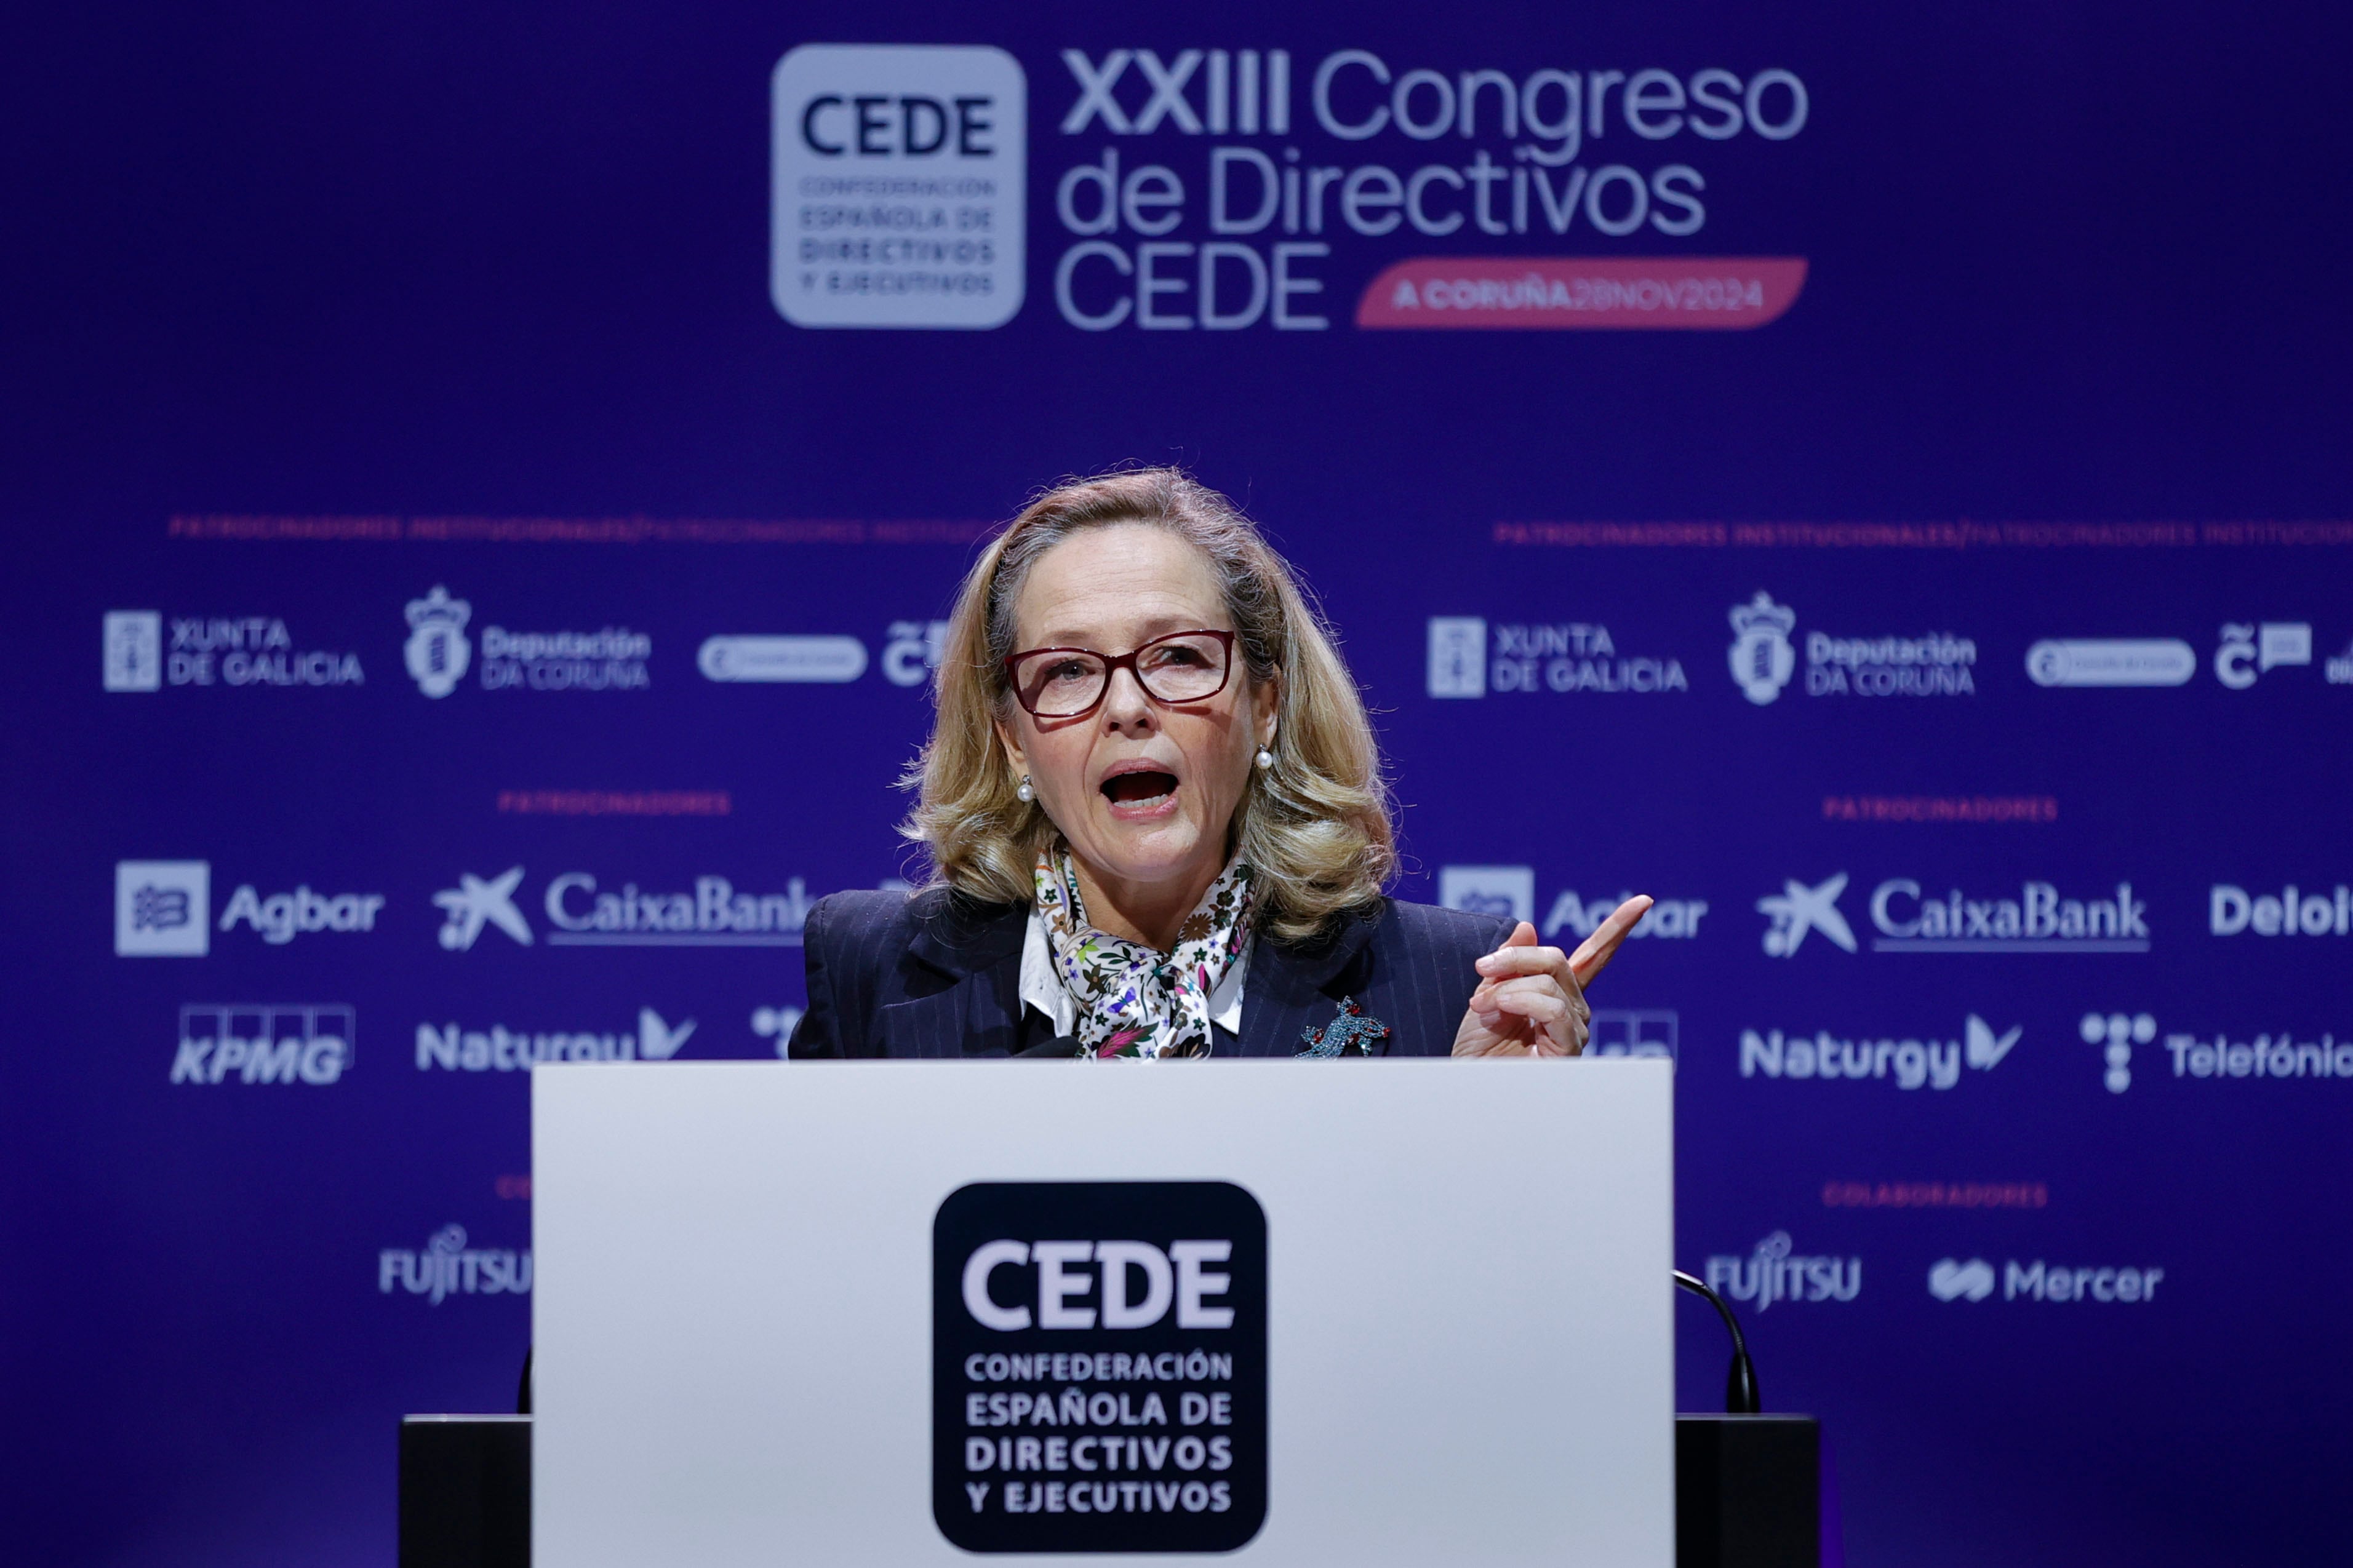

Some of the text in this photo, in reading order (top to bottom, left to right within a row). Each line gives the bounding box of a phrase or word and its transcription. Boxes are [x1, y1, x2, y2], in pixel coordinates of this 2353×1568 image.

[1062, 49, 1808, 167] XXIII Congreso
[801, 95, 994, 157] CEDE
[1057, 146, 1705, 236] de Directivos
[800, 205, 993, 230] ESPAÑOLA DE
[799, 238, 995, 264] DIRECTIVOS
[800, 271, 994, 295] Y EJECUTIVOS
[1055, 241, 1330, 330] CEDE
[1392, 279, 1421, 309] A
[1493, 521, 1727, 546] PATROCINADORES
[172, 618, 292, 652] XUNTA
[482, 626, 651, 664] Deputación
[1495, 624, 1615, 658] XUNTA
[1806, 632, 1977, 669] Deputación
[168, 652, 365, 686] DE GALICIA
[481, 658, 650, 690] DA CORUÑA
[1492, 658, 1688, 693] DE GALICIA
[1805, 666, 1975, 696] DA CORUÑA
[1823, 797, 2058, 822] PATROCINADORES
[219, 885, 385, 944] Agbar
[1870, 880, 2148, 937] CaixaBank
[2210, 885, 2353, 936] Deloi
[170, 1035, 347, 1084] KPMG
[1740, 1030, 1960, 1089] Naturgy
[1822, 1182, 2048, 1208] COLABORADORES
[962, 1240, 1234, 1331] CEDE
[1704, 1232, 1861, 1311] FUJITSU
[2005, 1260, 2163, 1301] Mercer
[965, 1348, 1232, 1381] CONFEDERACIÓN
[967, 1387, 1231, 1426] ESPAÑOLA DE
[966, 1436, 1232, 1471] DIRECTIVOS
[966, 1481, 1231, 1513] Y EJECUTIVOS
